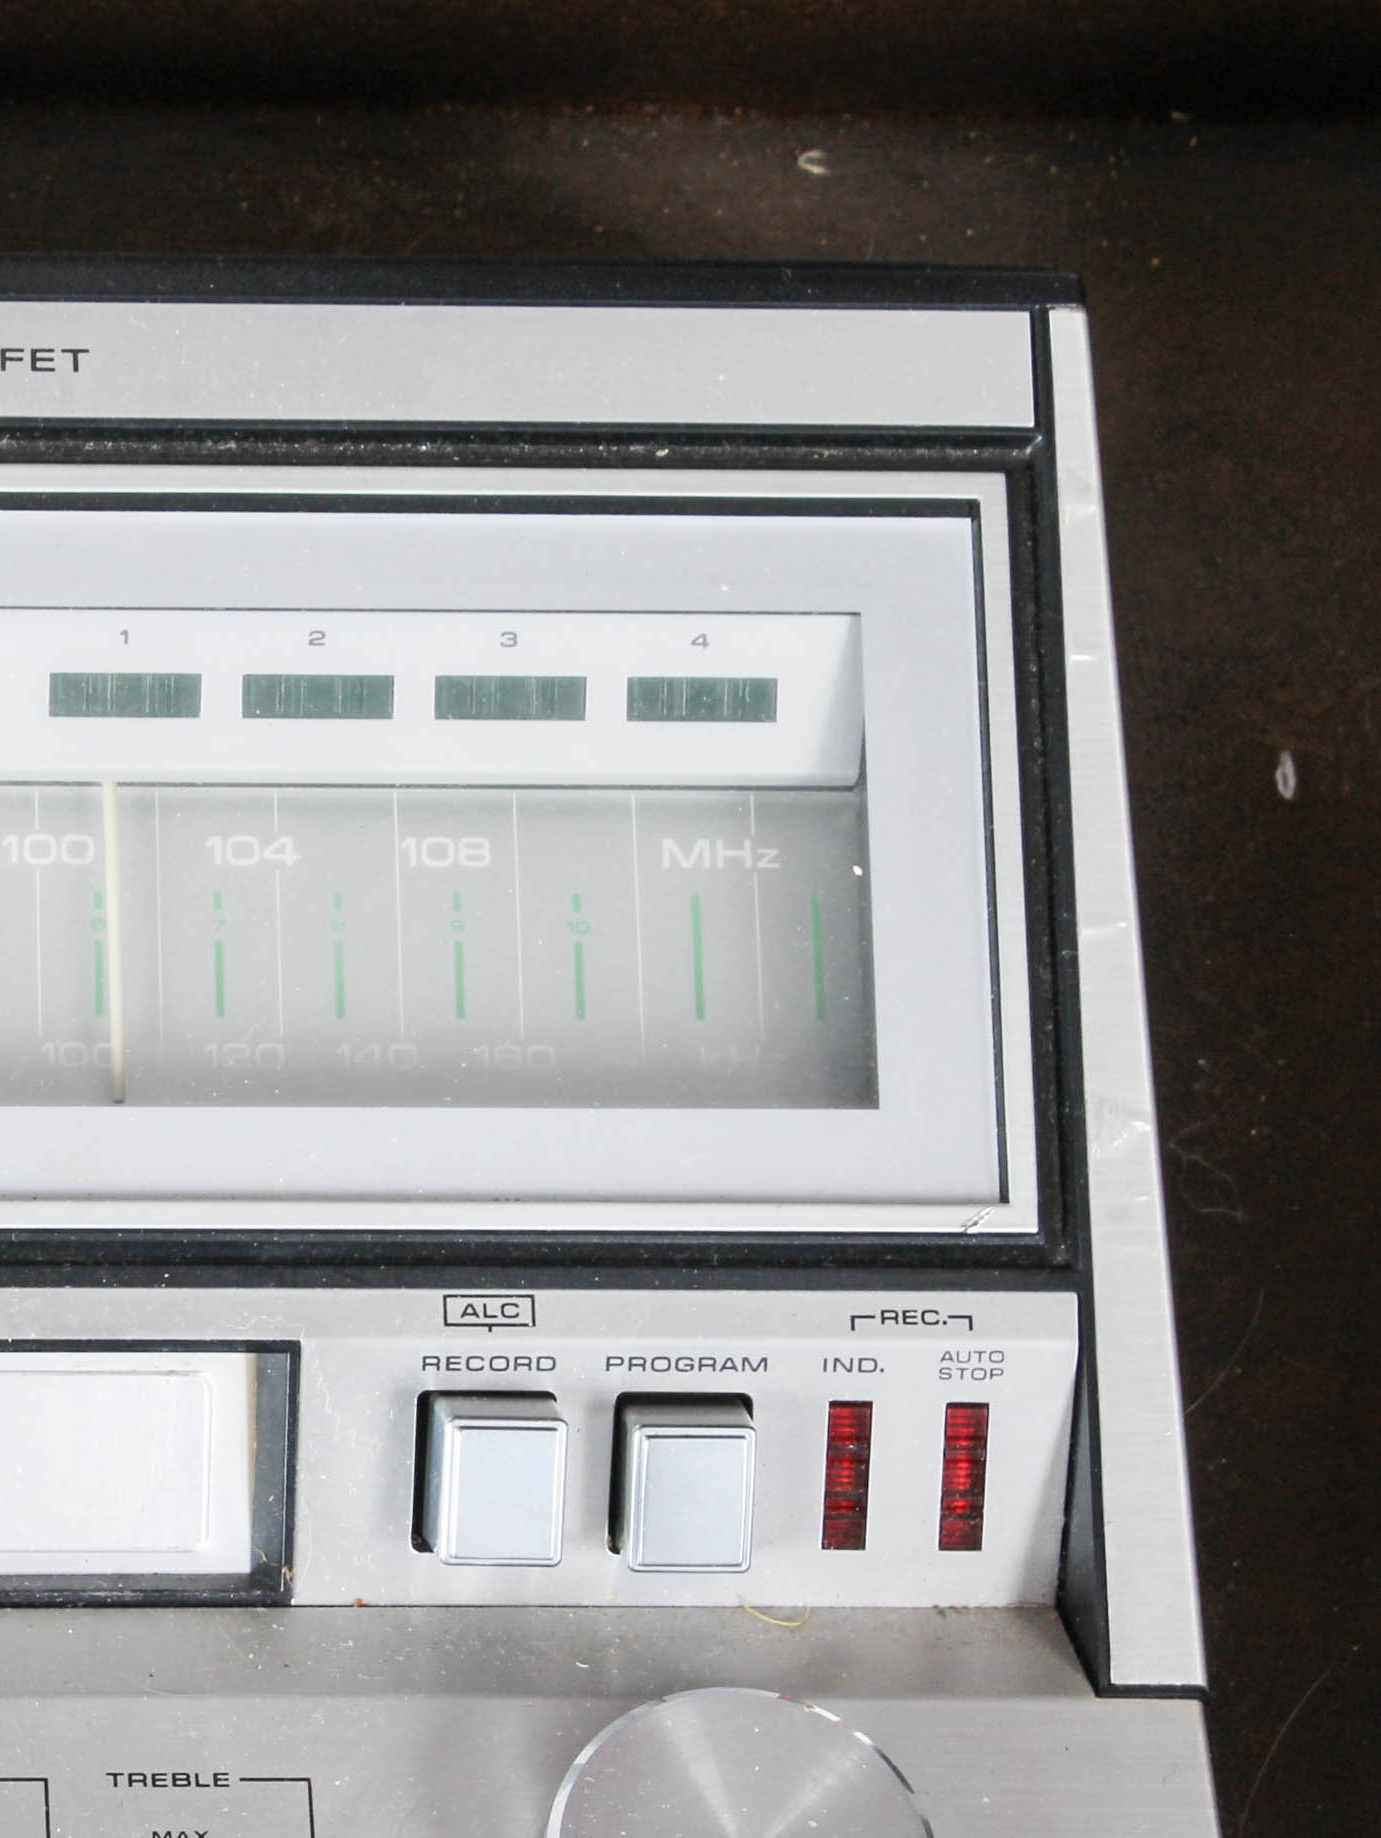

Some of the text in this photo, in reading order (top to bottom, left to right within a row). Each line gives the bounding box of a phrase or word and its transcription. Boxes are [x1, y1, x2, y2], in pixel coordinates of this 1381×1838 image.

[119, 629, 129, 645] 1
[307, 629, 327, 647] 2
[499, 631, 518, 648] 3
[690, 633, 710, 649] 4
[1, 833, 96, 866] 100
[205, 835, 302, 867] 104
[399, 836, 491, 868] 108
[661, 838, 781, 870] MHz
[204, 1042, 285, 1069] 120
[335, 1043, 419, 1070] 140
[473, 1044, 556, 1070] 160
[460, 1302, 520, 1320] ALC
[880, 1309, 948, 1326] REC.
[421, 1355, 557, 1372] RECORD
[605, 1355, 768, 1373] PROGRAM
[822, 1357, 885, 1374] IND.
[939, 1350, 1005, 1364] AUTO
[938, 1366, 1005, 1381] STOP
[105, 1772, 231, 1788] TREBLE
